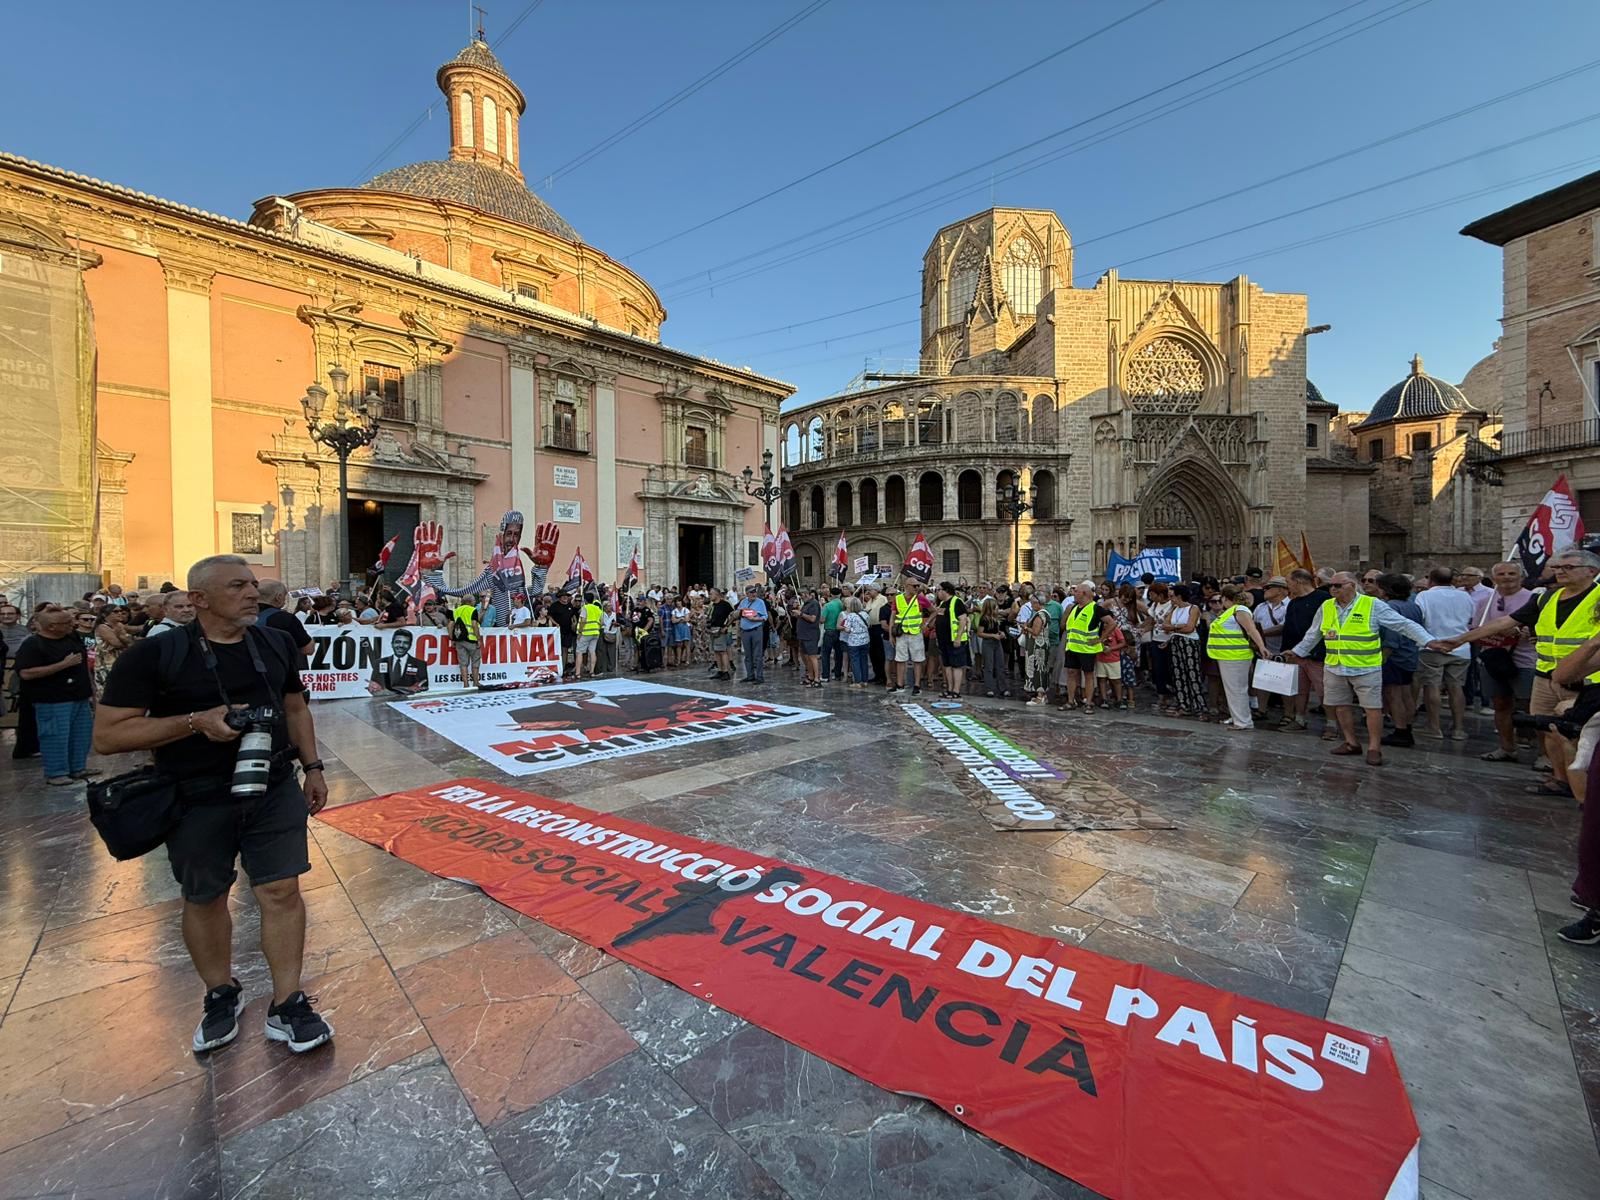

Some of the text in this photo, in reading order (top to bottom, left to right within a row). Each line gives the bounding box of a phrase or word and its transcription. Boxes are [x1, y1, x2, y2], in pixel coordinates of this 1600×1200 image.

[910, 557, 931, 574] CGT
[299, 629, 560, 671] ZÓN CRMINAL
[302, 673, 359, 683] ES NOSTRES
[311, 682, 336, 692] FANG
[434, 674, 449, 683] LES
[487, 672, 508, 681] SANG
[514, 710, 801, 763] CRIMINAL
[420, 814, 664, 914] ACORD SOCIAL
[428, 785, 1324, 1091] PER LA RECONSTRUCCIÓ SOCIAL DEL PAÍS
[719, 915, 1098, 1098] VALENCIÀ
